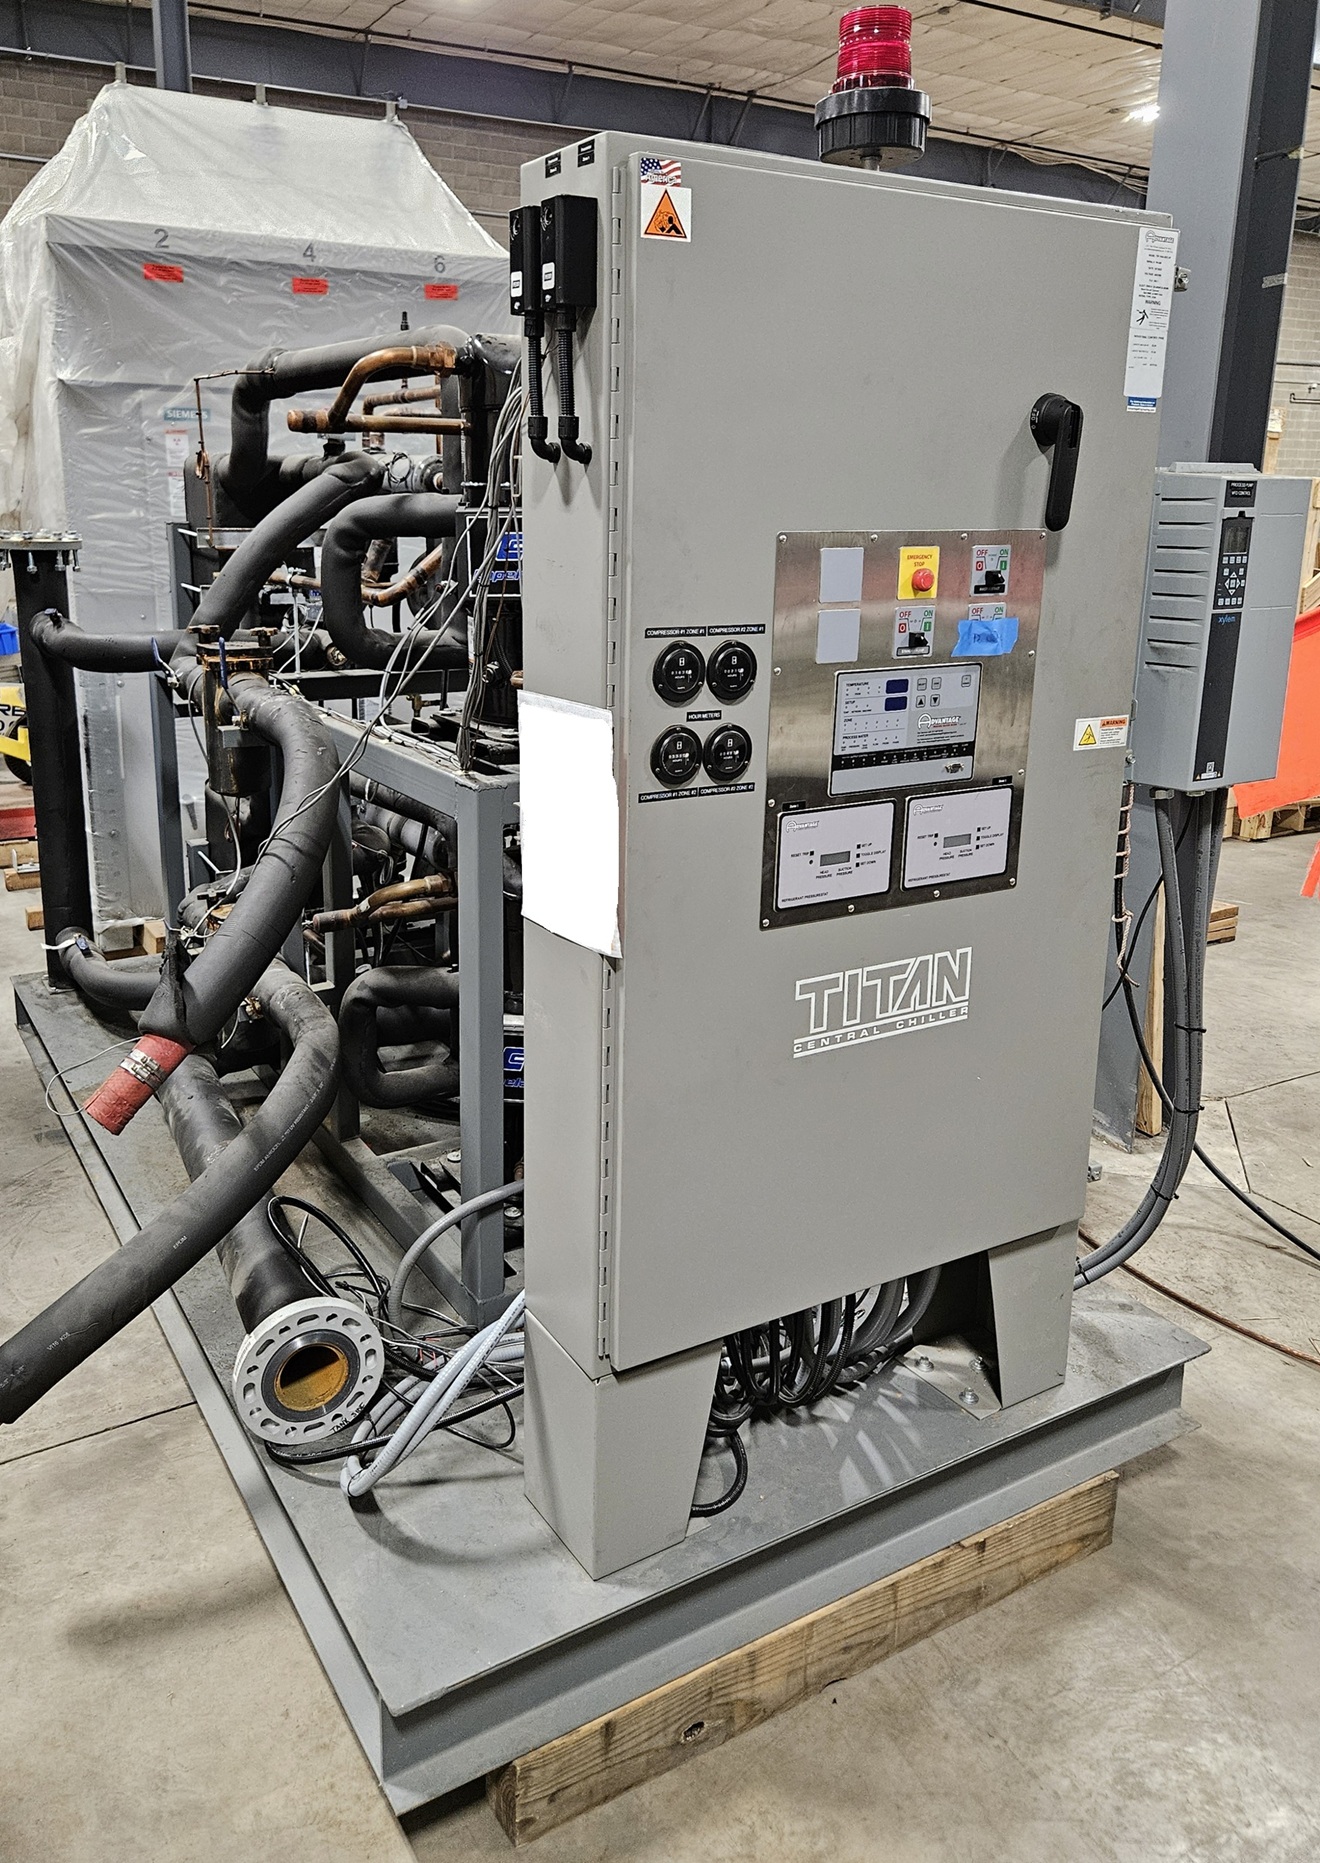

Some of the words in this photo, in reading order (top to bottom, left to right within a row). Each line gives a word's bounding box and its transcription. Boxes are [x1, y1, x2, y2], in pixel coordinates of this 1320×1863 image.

[154, 228, 170, 248] 2
[302, 242, 316, 262] 4
[434, 255, 446, 273] 6
[640, 792, 672, 800] COMPRESSOR
[795, 946, 972, 1034] TITAN
[793, 1026, 880, 1053] CENTRAL
[896, 1006, 968, 1029] CHILLER
[330, 1418, 350, 1432] TANK
